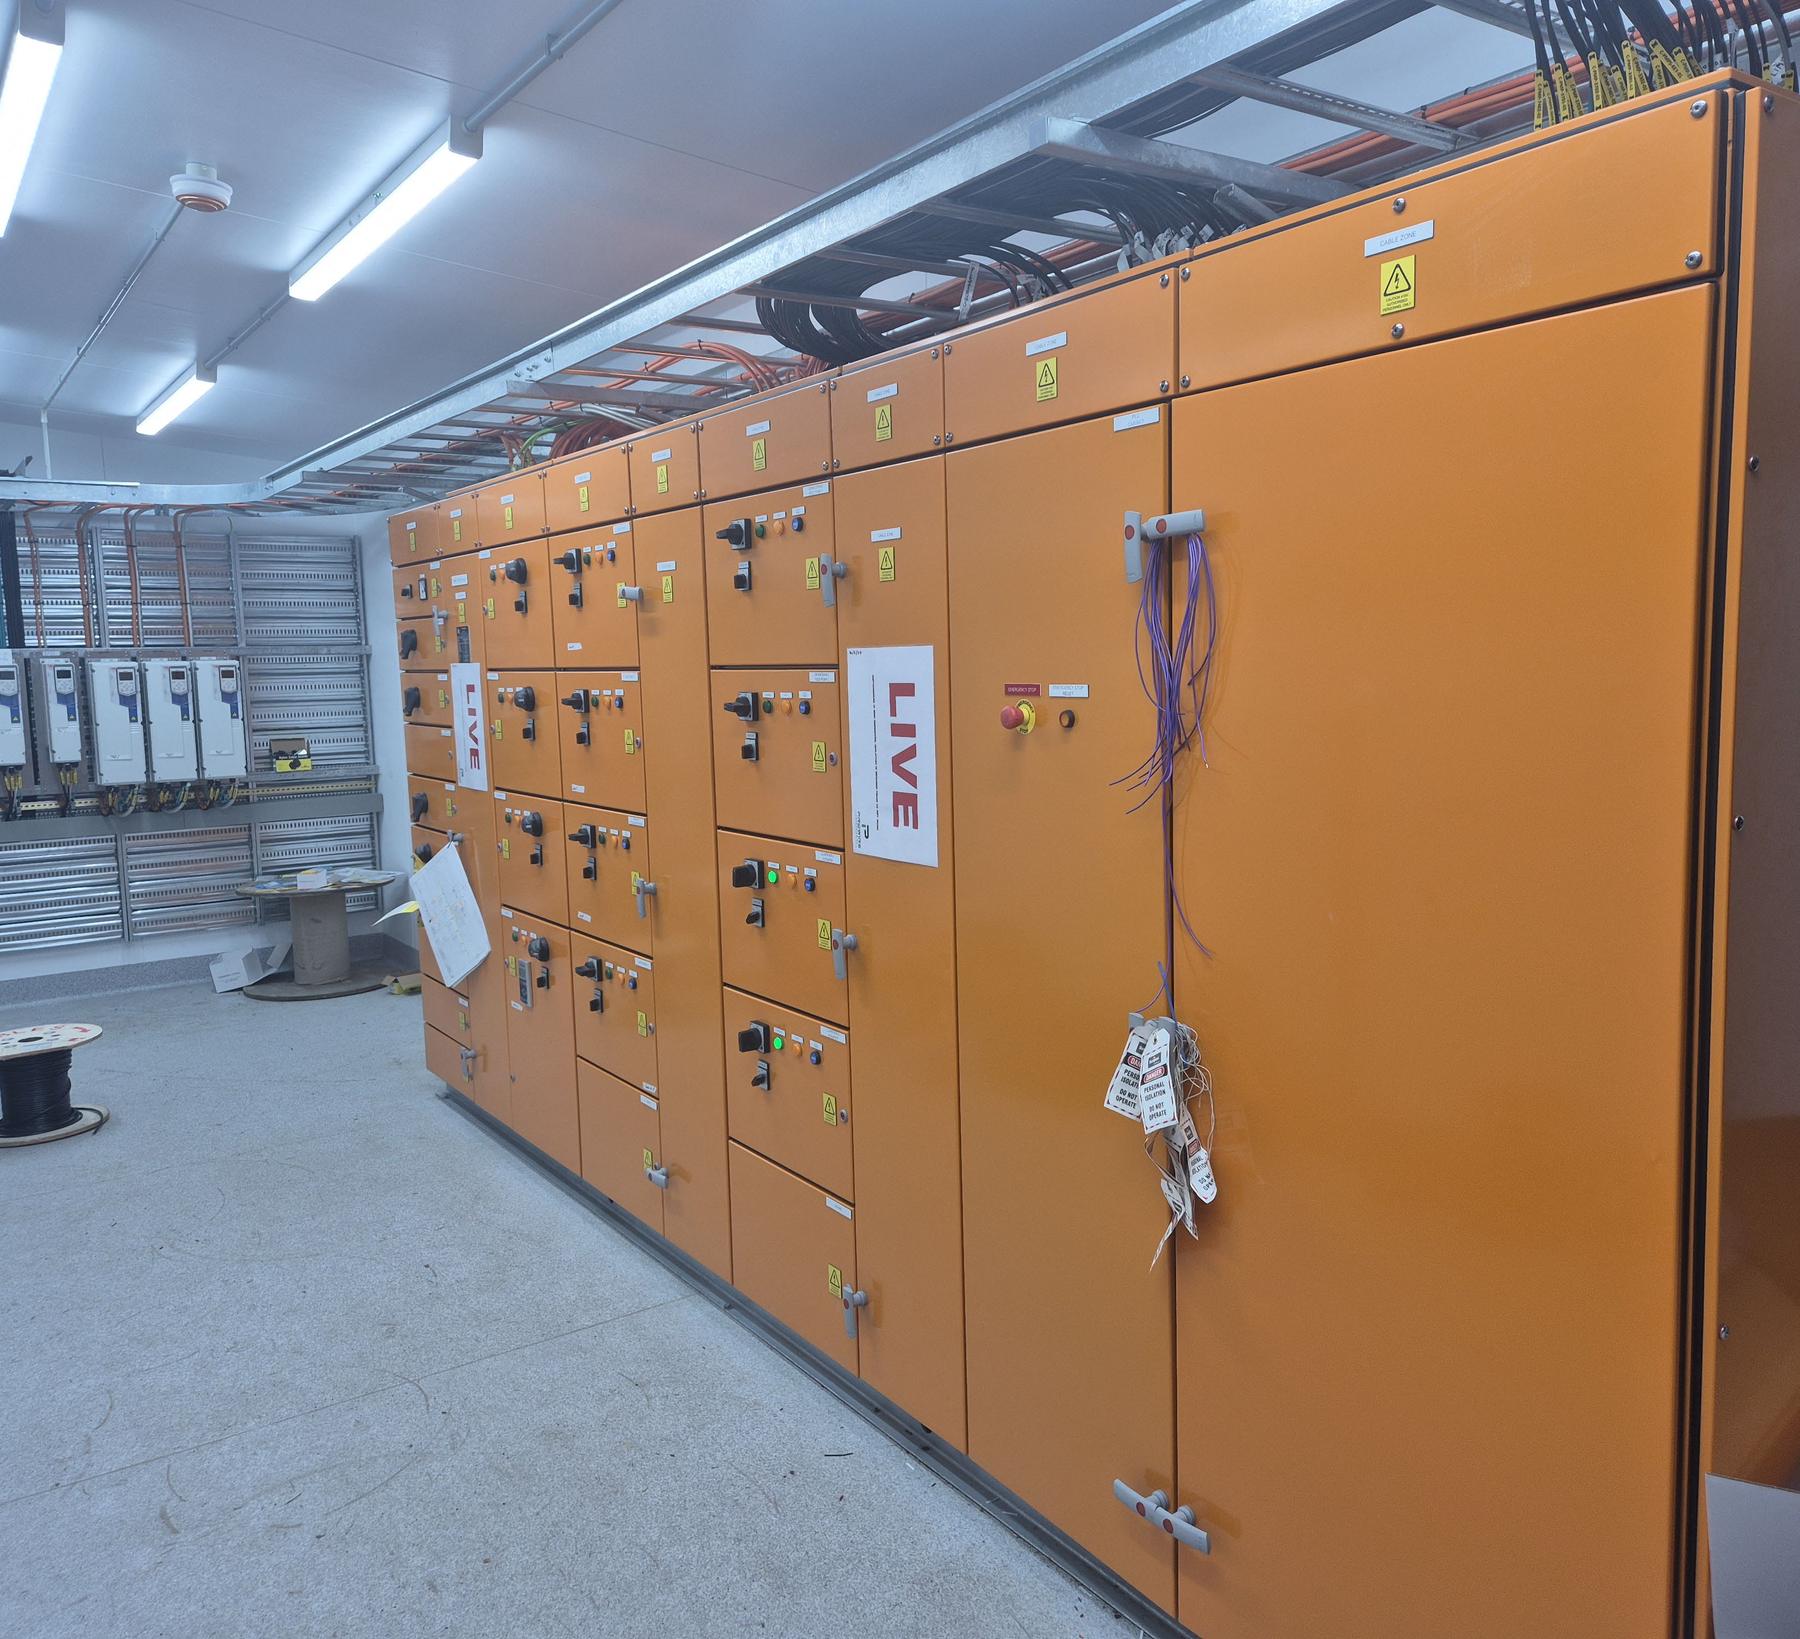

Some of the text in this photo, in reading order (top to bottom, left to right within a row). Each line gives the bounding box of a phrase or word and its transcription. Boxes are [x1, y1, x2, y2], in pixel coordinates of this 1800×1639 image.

[1380, 230, 1416, 247] CABLE ZONE
[466, 684, 481, 771] LIVE
[889, 682, 919, 830] LIVE
[1124, 1069, 1140, 1081] PERSO
[1120, 1077, 1139, 1090] ISOLATI
[1144, 1083, 1165, 1093] PERSONAL
[1119, 1088, 1138, 1100] DO NOT
[1145, 1089, 1166, 1101] ISOLATION
[1115, 1095, 1137, 1108] OPERATE
[1156, 1102, 1165, 1110] NOT
[1149, 1110, 1167, 1120] OPERATE
